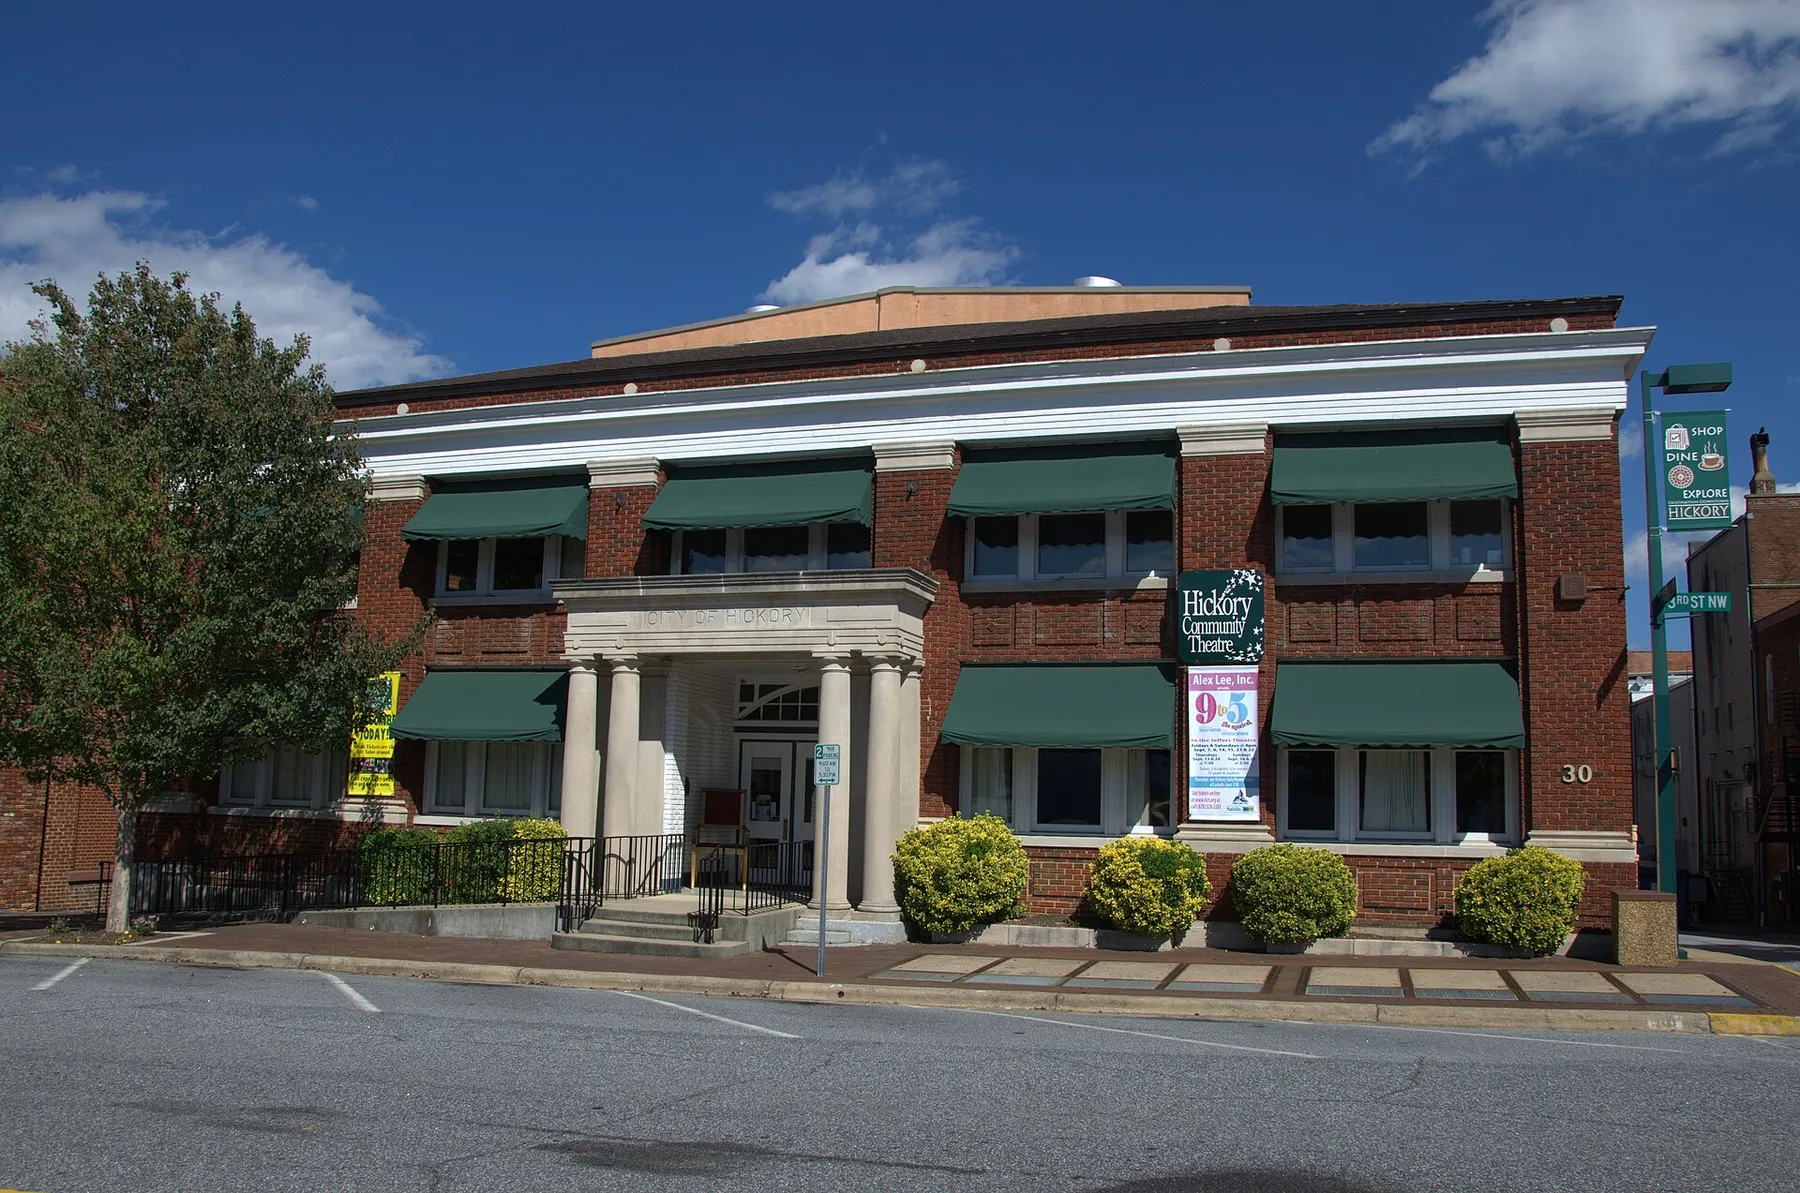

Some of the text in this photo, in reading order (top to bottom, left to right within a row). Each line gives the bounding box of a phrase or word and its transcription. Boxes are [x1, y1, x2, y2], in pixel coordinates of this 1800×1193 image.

[1691, 426, 1723, 436] SHOP
[1666, 452, 1698, 462] DINE
[1683, 489, 1728, 499] EXPLORE
[1668, 505, 1729, 518] HICKORY
[1182, 589, 1253, 620] Hickory
[1668, 595, 1727, 609] 3RD ST NW
[648, 608, 805, 625] CITY OF HICKORY
[1182, 616, 1246, 638] Community
[1187, 635, 1234, 653] Theatre
[1193, 674, 1254, 686] Alex Lee, Inc.
[1195, 691, 1248, 724] 9 to 5
[816, 747, 822, 757] 2
[1562, 764, 1592, 783] 30
